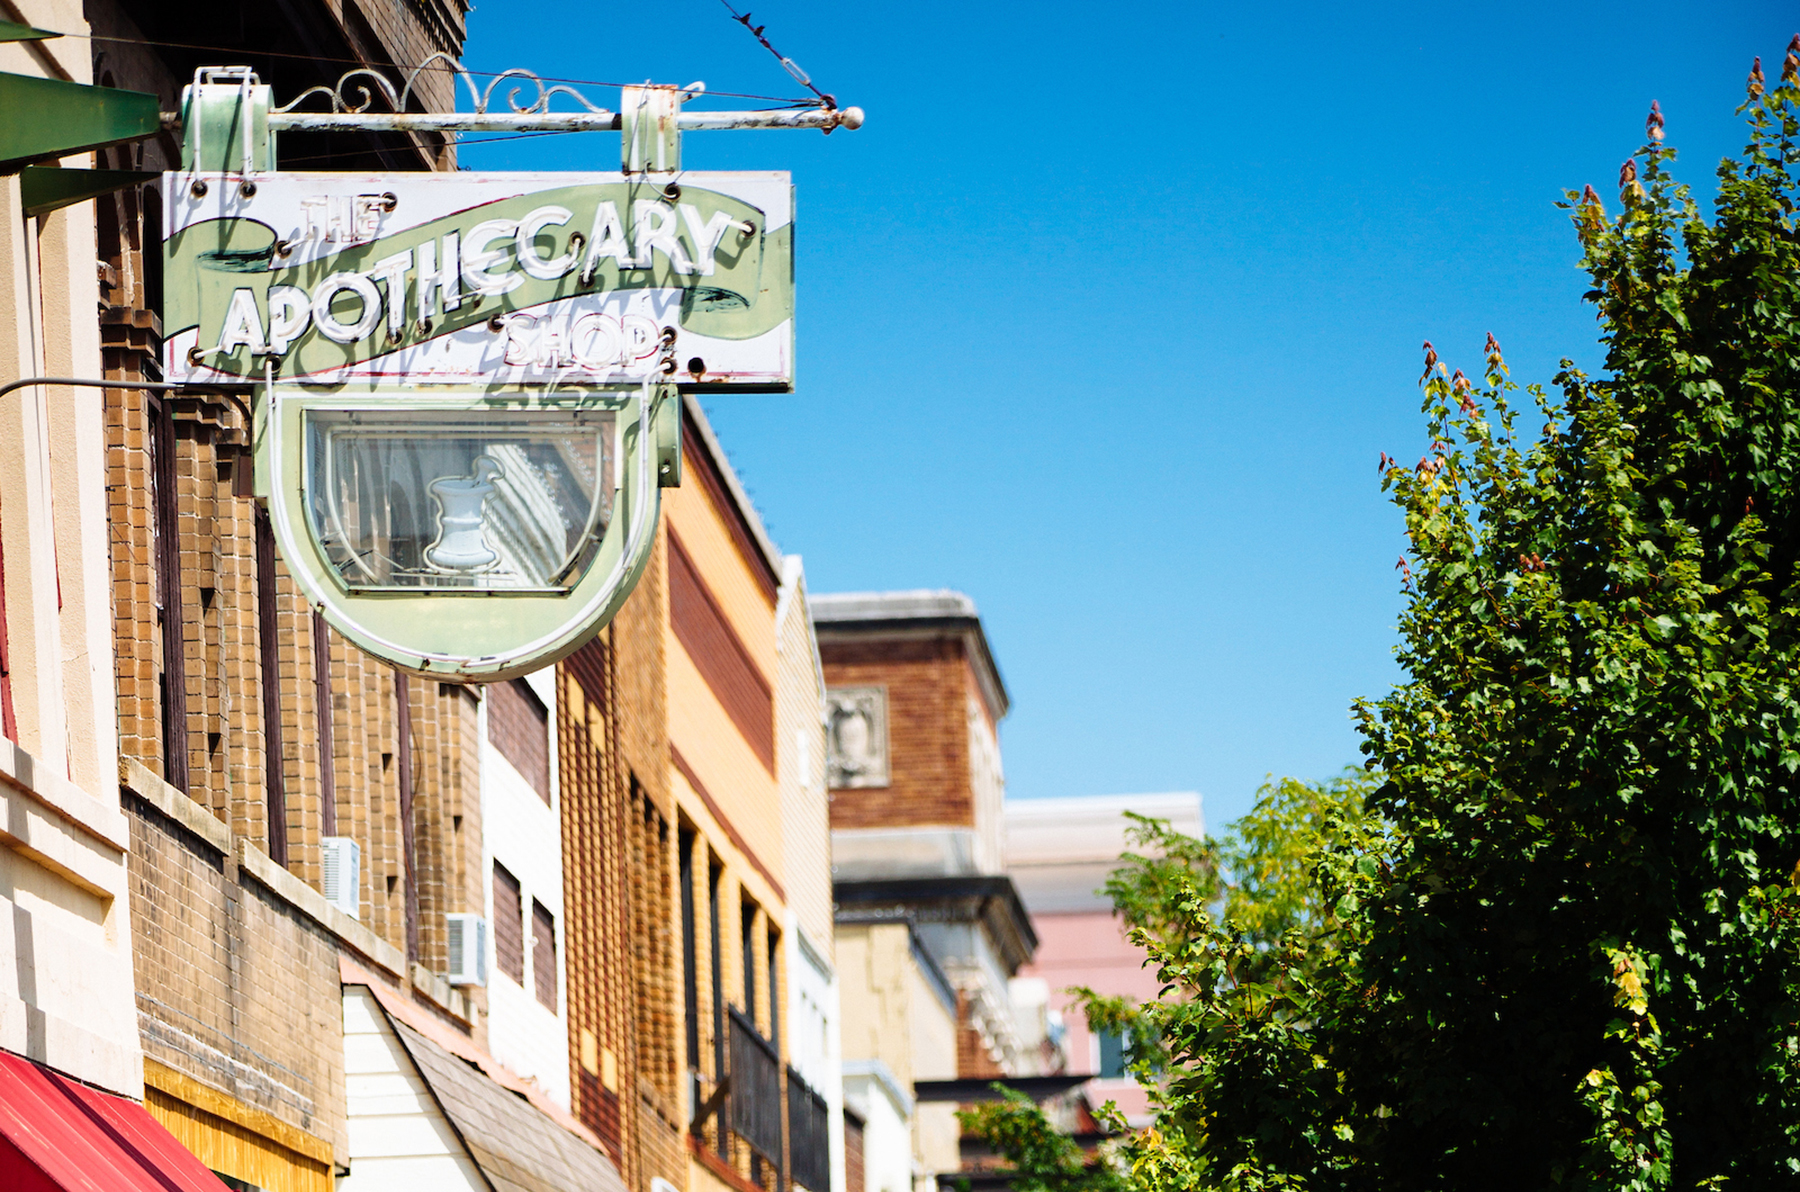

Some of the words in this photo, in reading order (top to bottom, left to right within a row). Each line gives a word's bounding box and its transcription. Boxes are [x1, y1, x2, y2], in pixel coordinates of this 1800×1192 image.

[299, 195, 381, 243] THE
[220, 200, 736, 357] APOTHECARY
[503, 312, 660, 369] SHOP
